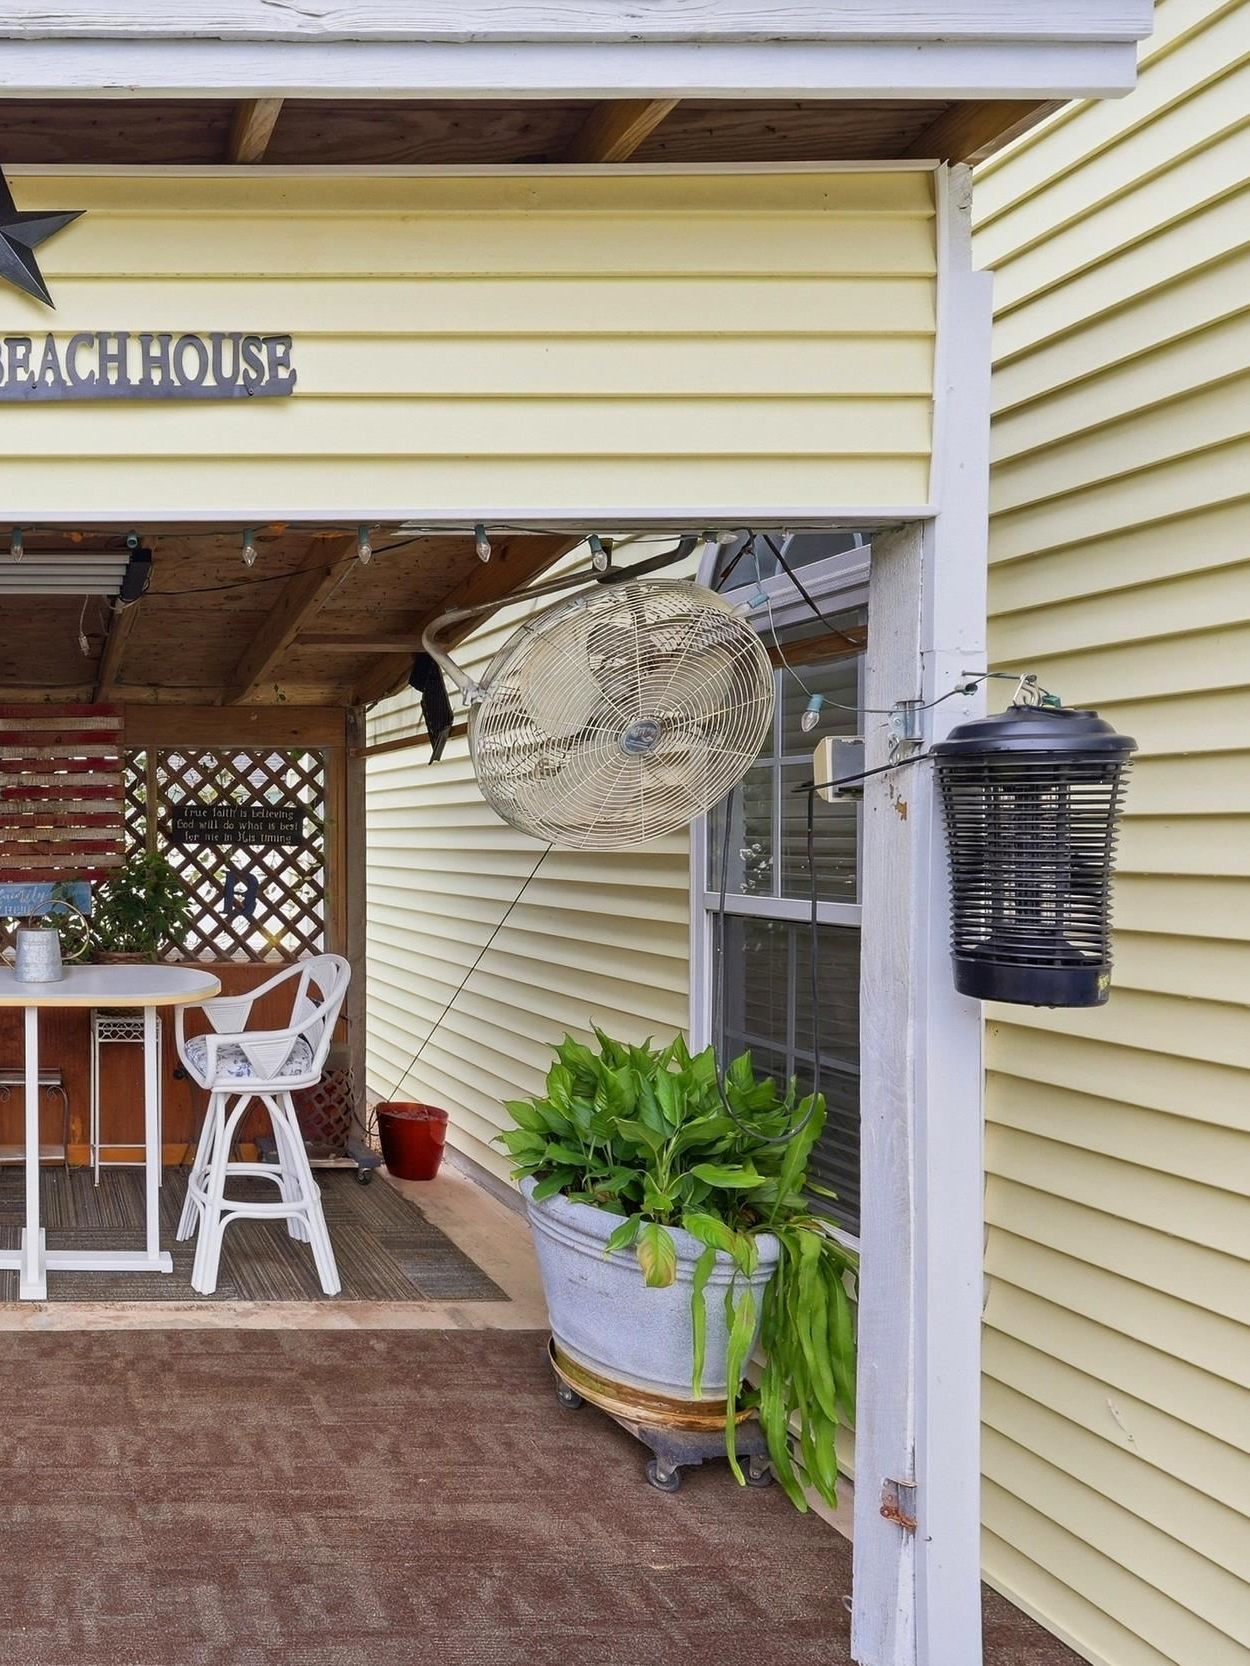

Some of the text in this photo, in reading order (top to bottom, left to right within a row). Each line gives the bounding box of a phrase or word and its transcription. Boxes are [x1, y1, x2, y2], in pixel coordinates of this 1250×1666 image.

[136, 332, 297, 386] HOUSE
[184, 807, 294, 820] True faith is believing
[176, 818, 298, 831] God will do what is best
[185, 830, 292, 845] for me in His timing
